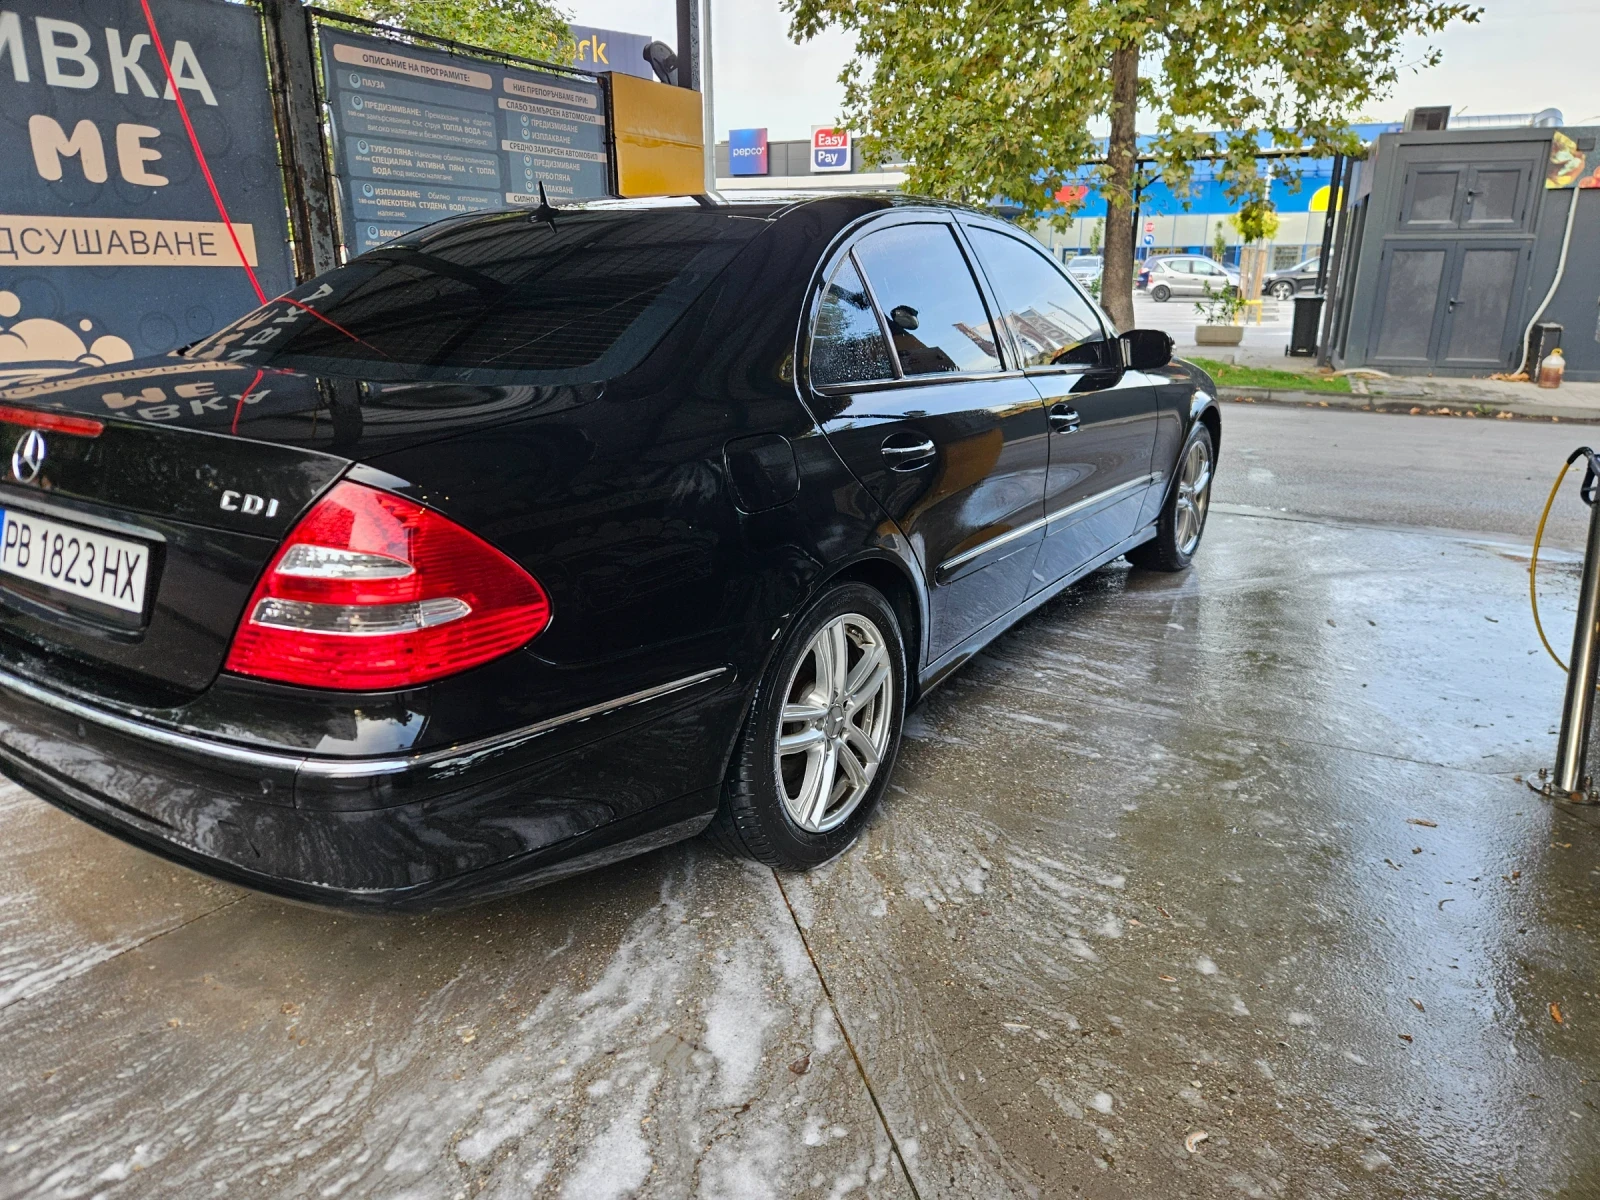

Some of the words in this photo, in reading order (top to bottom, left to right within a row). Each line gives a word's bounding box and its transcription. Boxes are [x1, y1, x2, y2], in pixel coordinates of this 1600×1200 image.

[362, 54, 406, 70] ОПИСАНИЕ
[408, 64, 419, 73] НА
[420, 65, 470, 82] ПРОГРАМИТЕ:
[362, 78, 385, 89] ПАУЗА
[513, 84, 526, 92] НИЕ
[526, 86, 574, 102] ПРЕПОРЪЧВАМЕ
[575, 96, 588, 104] ПРИ:
[364, 100, 422, 116] ПРЕДИЗМИВАНЕ:
[506, 101, 528, 111] СЛАБО
[528, 104, 560, 116] ЗАМЪРСЕН
[562, 112, 596, 122] АВТОМОБИЛ
[442, 124, 463, 133] ТОПЛА
[464, 126, 481, 136] ВОДА
[531, 119, 578, 132] ПРЕДИЗМИВАНЕ
[532, 132, 570, 144] ИЗПЛАКВАНЕ
[818, 134, 844, 147] Easy
[28, 114, 169, 186] МЕ
[370, 144, 392, 154] ТУРБО
[394, 148, 414, 156] ПЯНА:
[510, 142, 534, 152] СРЕДНО
[534, 144, 564, 156] ЗАМЪРСЕН
[565, 150, 598, 160] АВТОМОБИЛ
[733, 148, 762, 158] pepco
[818, 151, 838, 164] Pay
[371, 156, 412, 166] СПЕЦИАЛНА
[416, 160, 446, 170] АКТИВНА
[449, 164, 466, 172] ПЯНА
[476, 167, 496, 176] ТОПЛА
[534, 159, 580, 170] ПРЕДИЗМИВАНЕ
[372, 167, 392, 176] ВОДА
[535, 171, 554, 180] ТУРБО
[554, 174, 570, 182] ПЯНА
[375, 188, 420, 198] ИЗПЛАКВАНЕ:
[536, 185, 574, 194] ИПЛАКВАНЕ
[376, 199, 416, 208] ОМЕКОТЕНА
[419, 202, 446, 211] СТУДЕНА
[450, 204, 466, 212] ВОДА
[514, 195, 535, 203] СИЛНО
[220, 490, 279, 518] CDI
[4, 520, 32, 568] PB
[41, 530, 96, 587] 1823
[100, 546, 140, 602] HX
